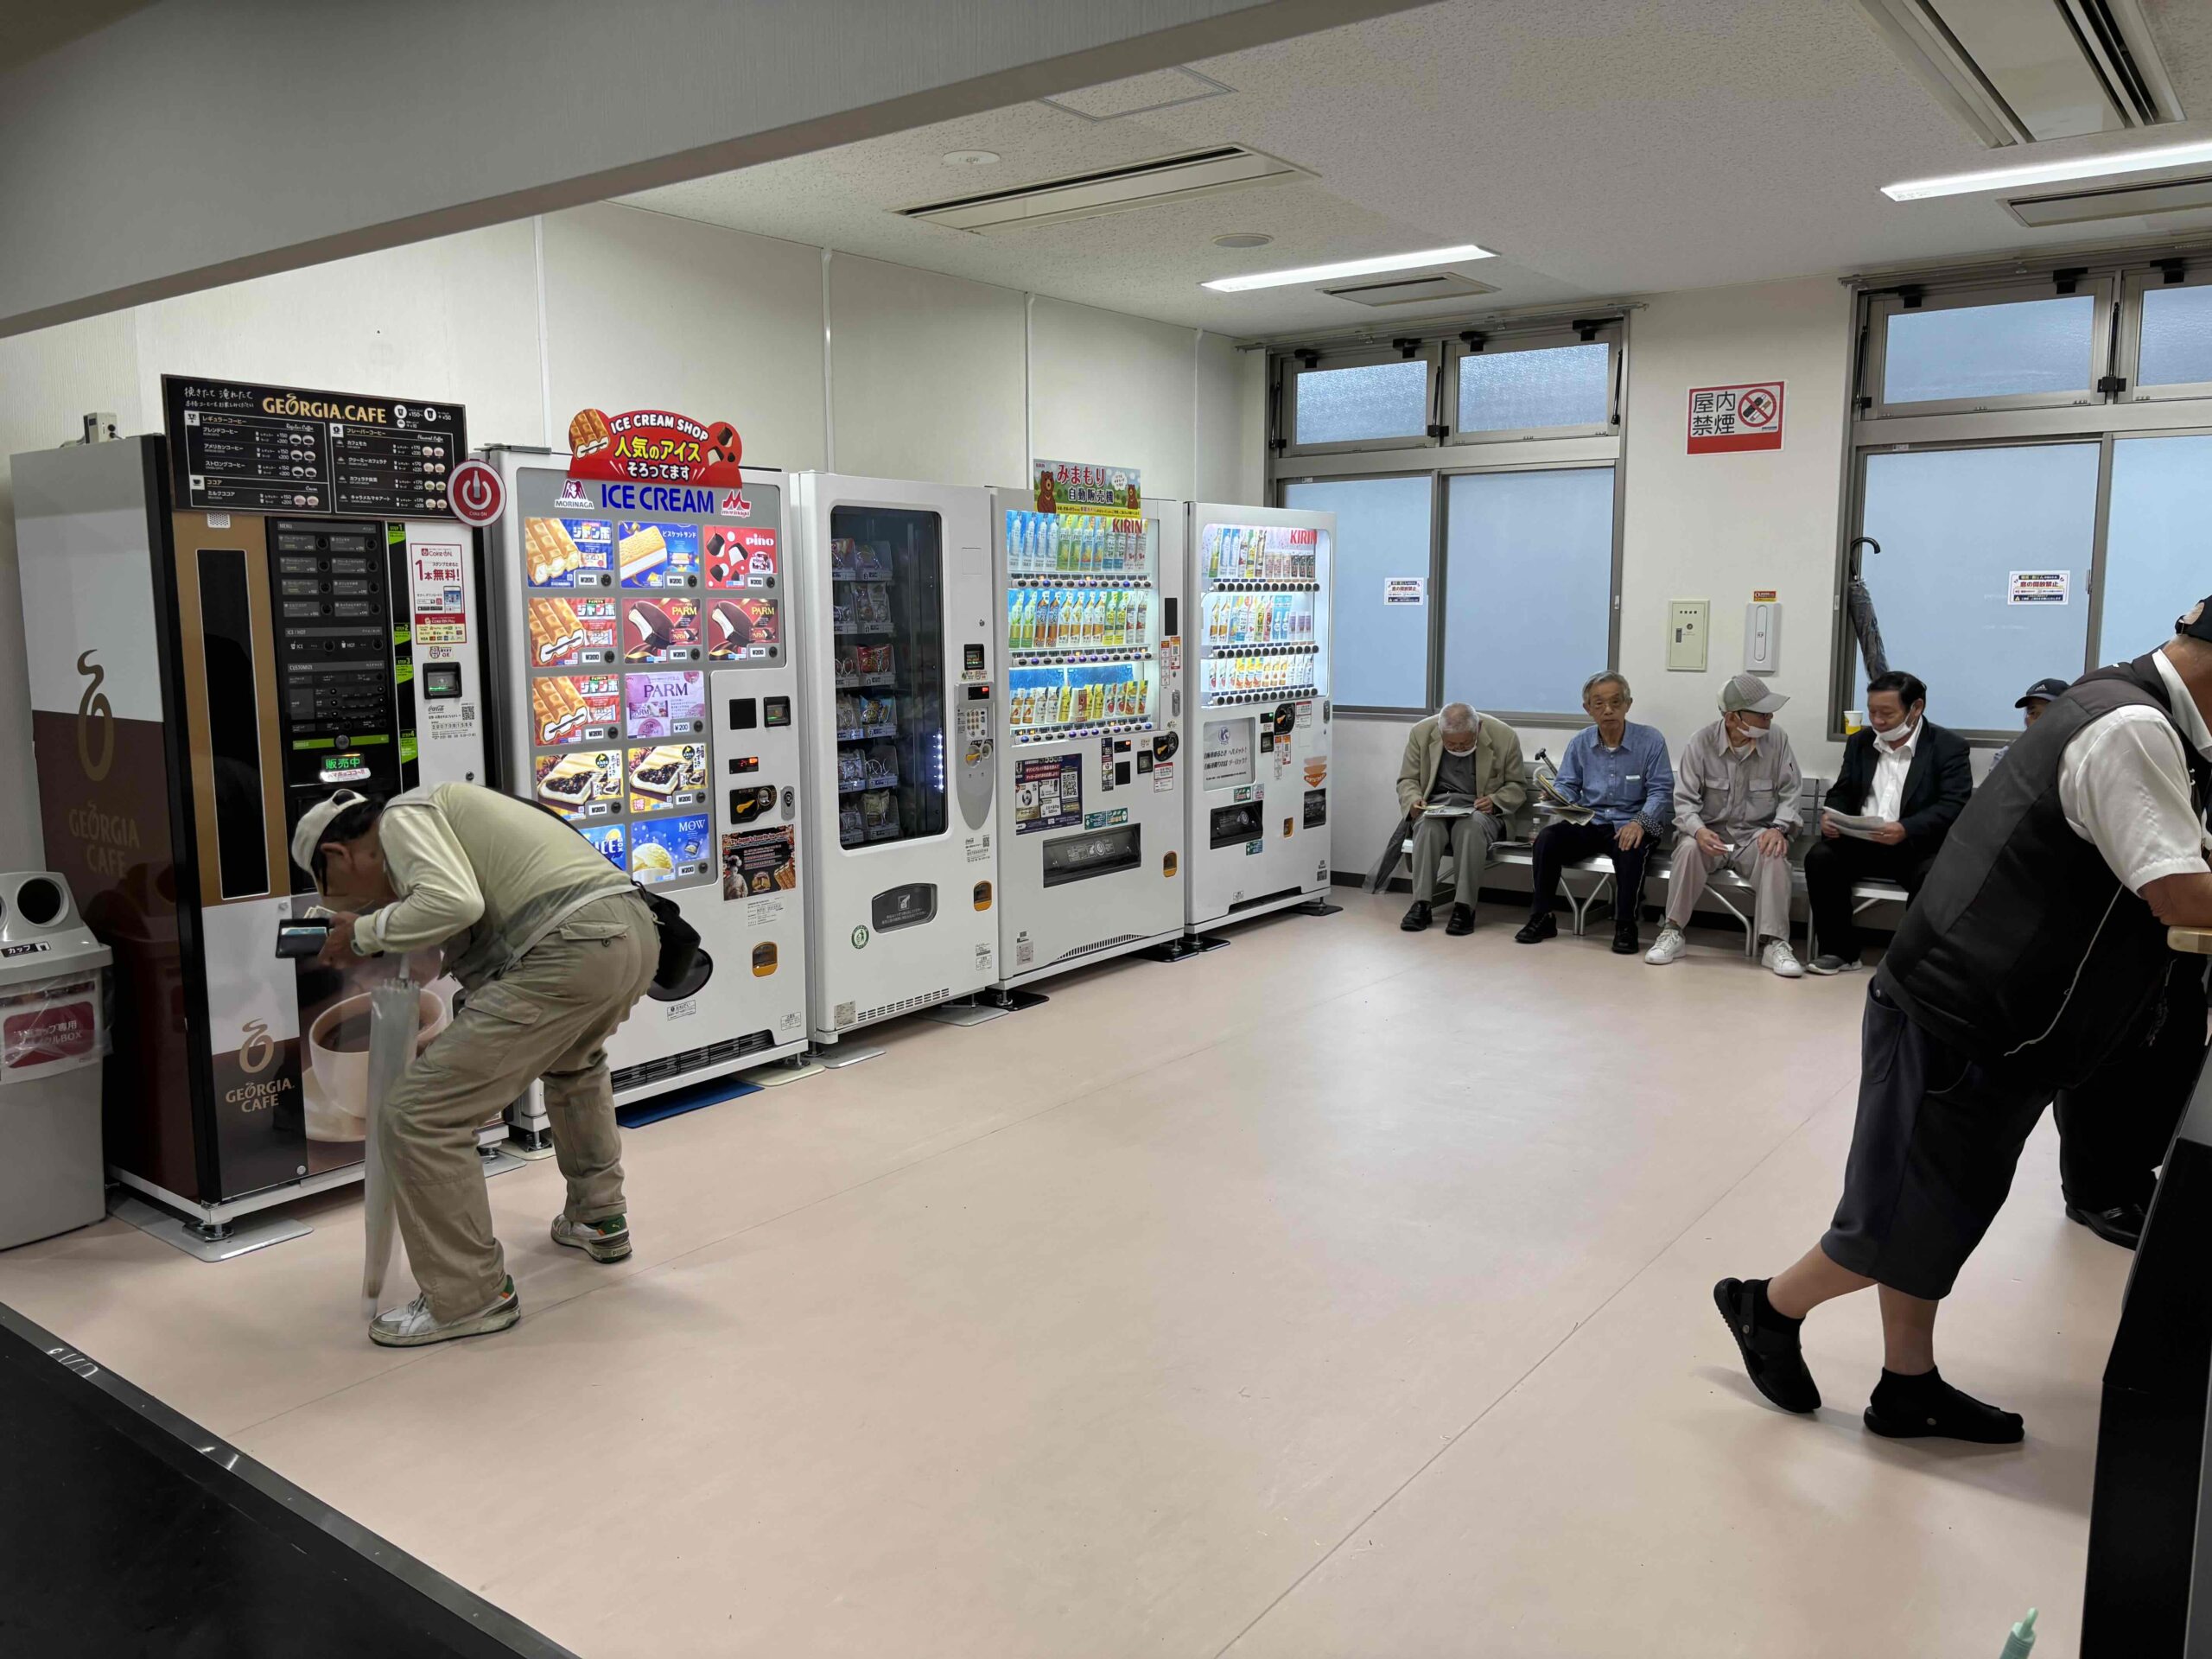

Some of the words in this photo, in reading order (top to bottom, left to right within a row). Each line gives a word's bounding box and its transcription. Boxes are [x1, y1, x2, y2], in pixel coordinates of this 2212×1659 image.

[184, 386, 216, 398] 挽きたて
[262, 392, 343, 420] GEORGIA
[344, 404, 387, 423] CAFE
[1693, 391, 1736, 414] 屋内
[202, 415, 248, 424] レギュラーコーヒー
[610, 416, 631, 435] ICE
[633, 413, 675, 429] CREAM
[676, 419, 709, 442] SHOP
[1692, 414, 1735, 436] 禁煙
[614, 435, 702, 463] 人気のアイス
[626, 461, 690, 481] そろってます
[1057, 464, 1106, 486] みまもり
[555, 500, 594, 509] MORINAGA
[601, 483, 636, 510] ICE
[639, 486, 715, 514] CREAM
[1068, 487, 1116, 505] 自動販売機
[1113, 518, 1143, 534] KIRIN
[746, 533, 774, 546] pino
[1290, 530, 1318, 545] KIRIN
[671, 607, 697, 616] PARM
[751, 607, 775, 615] PARM
[644, 683, 689, 698] PARM
[326, 757, 360, 769] 販売中
[69, 801, 140, 849] GEORGIA
[678, 818, 706, 832] MOW
[87, 844, 126, 880] CAFE
[7, 944, 31, 955] カップ
[226, 1077, 292, 1103] GEORGIA
[241, 1093, 279, 1113] CAFE
